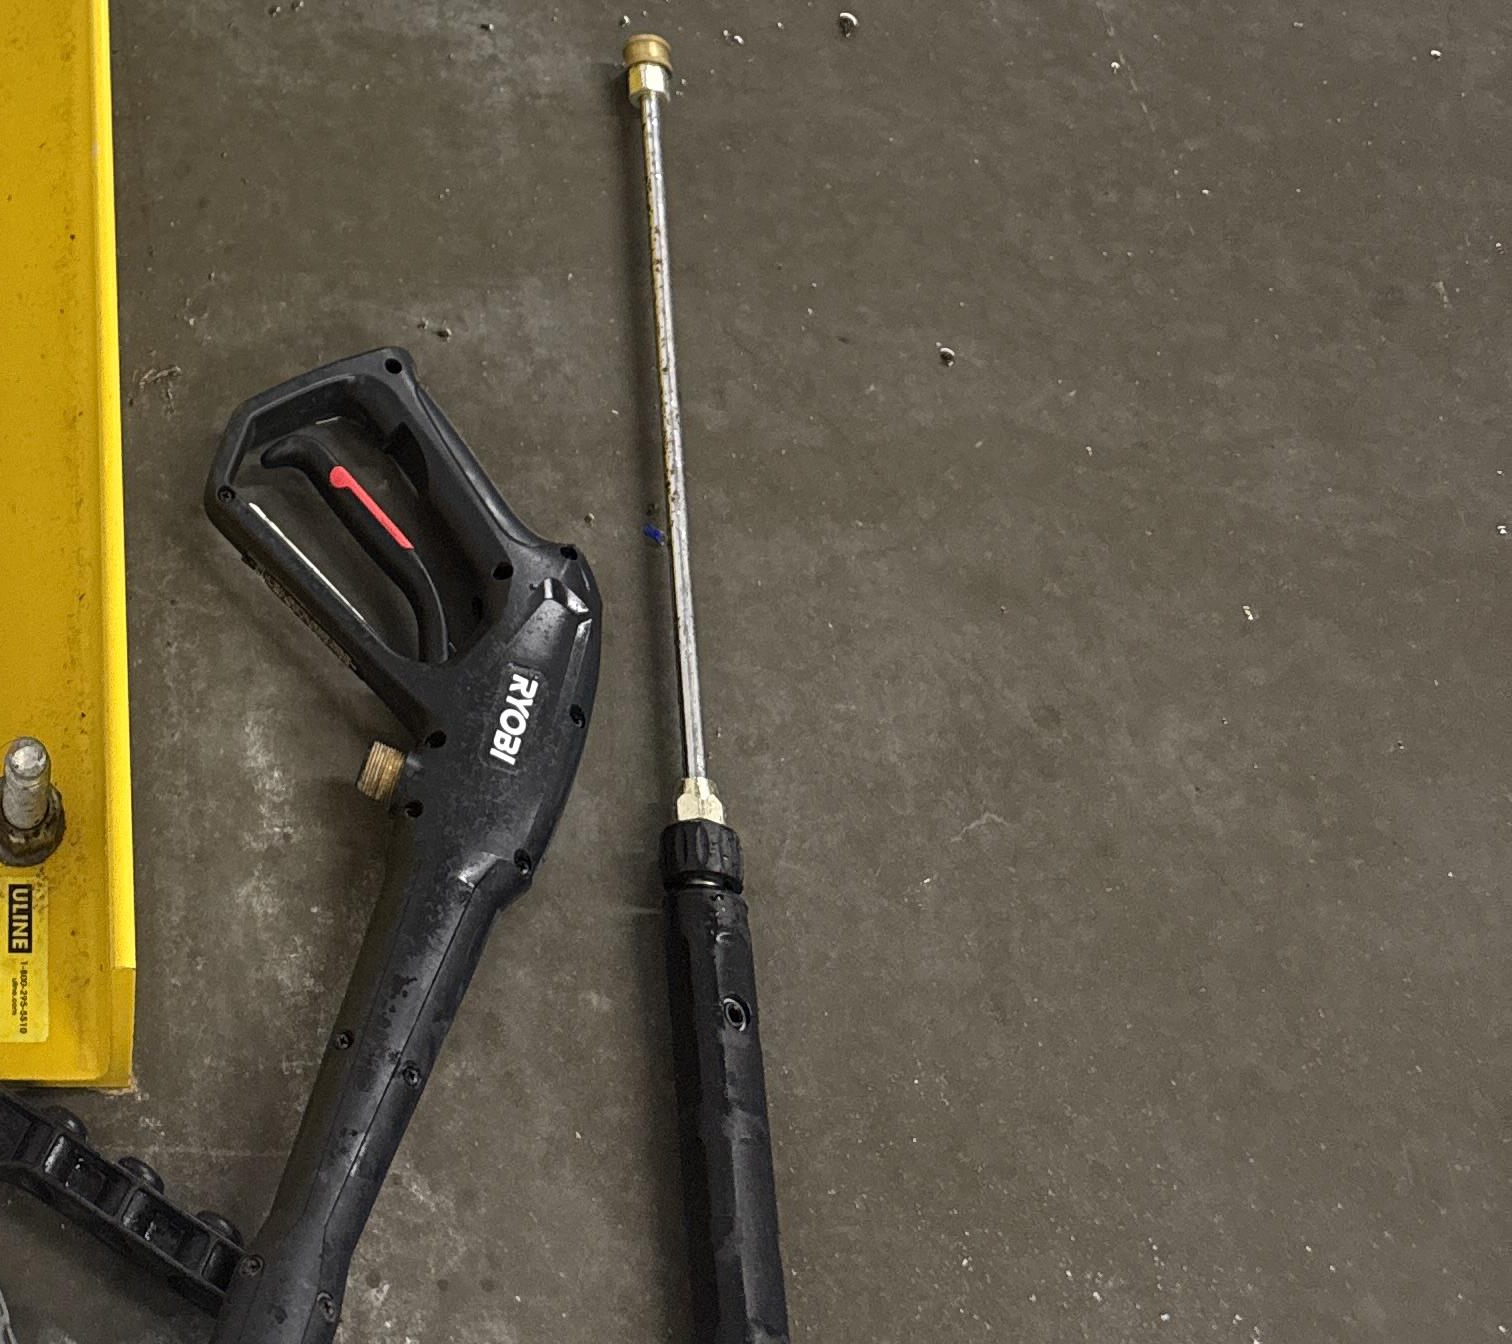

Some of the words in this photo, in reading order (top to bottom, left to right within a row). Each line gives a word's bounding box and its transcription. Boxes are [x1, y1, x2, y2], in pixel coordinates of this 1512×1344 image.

[489, 673, 539, 766] RYOBI
[11, 888, 29, 950] ULINE
[19, 960, 28, 1034] 1-800-295-5510
